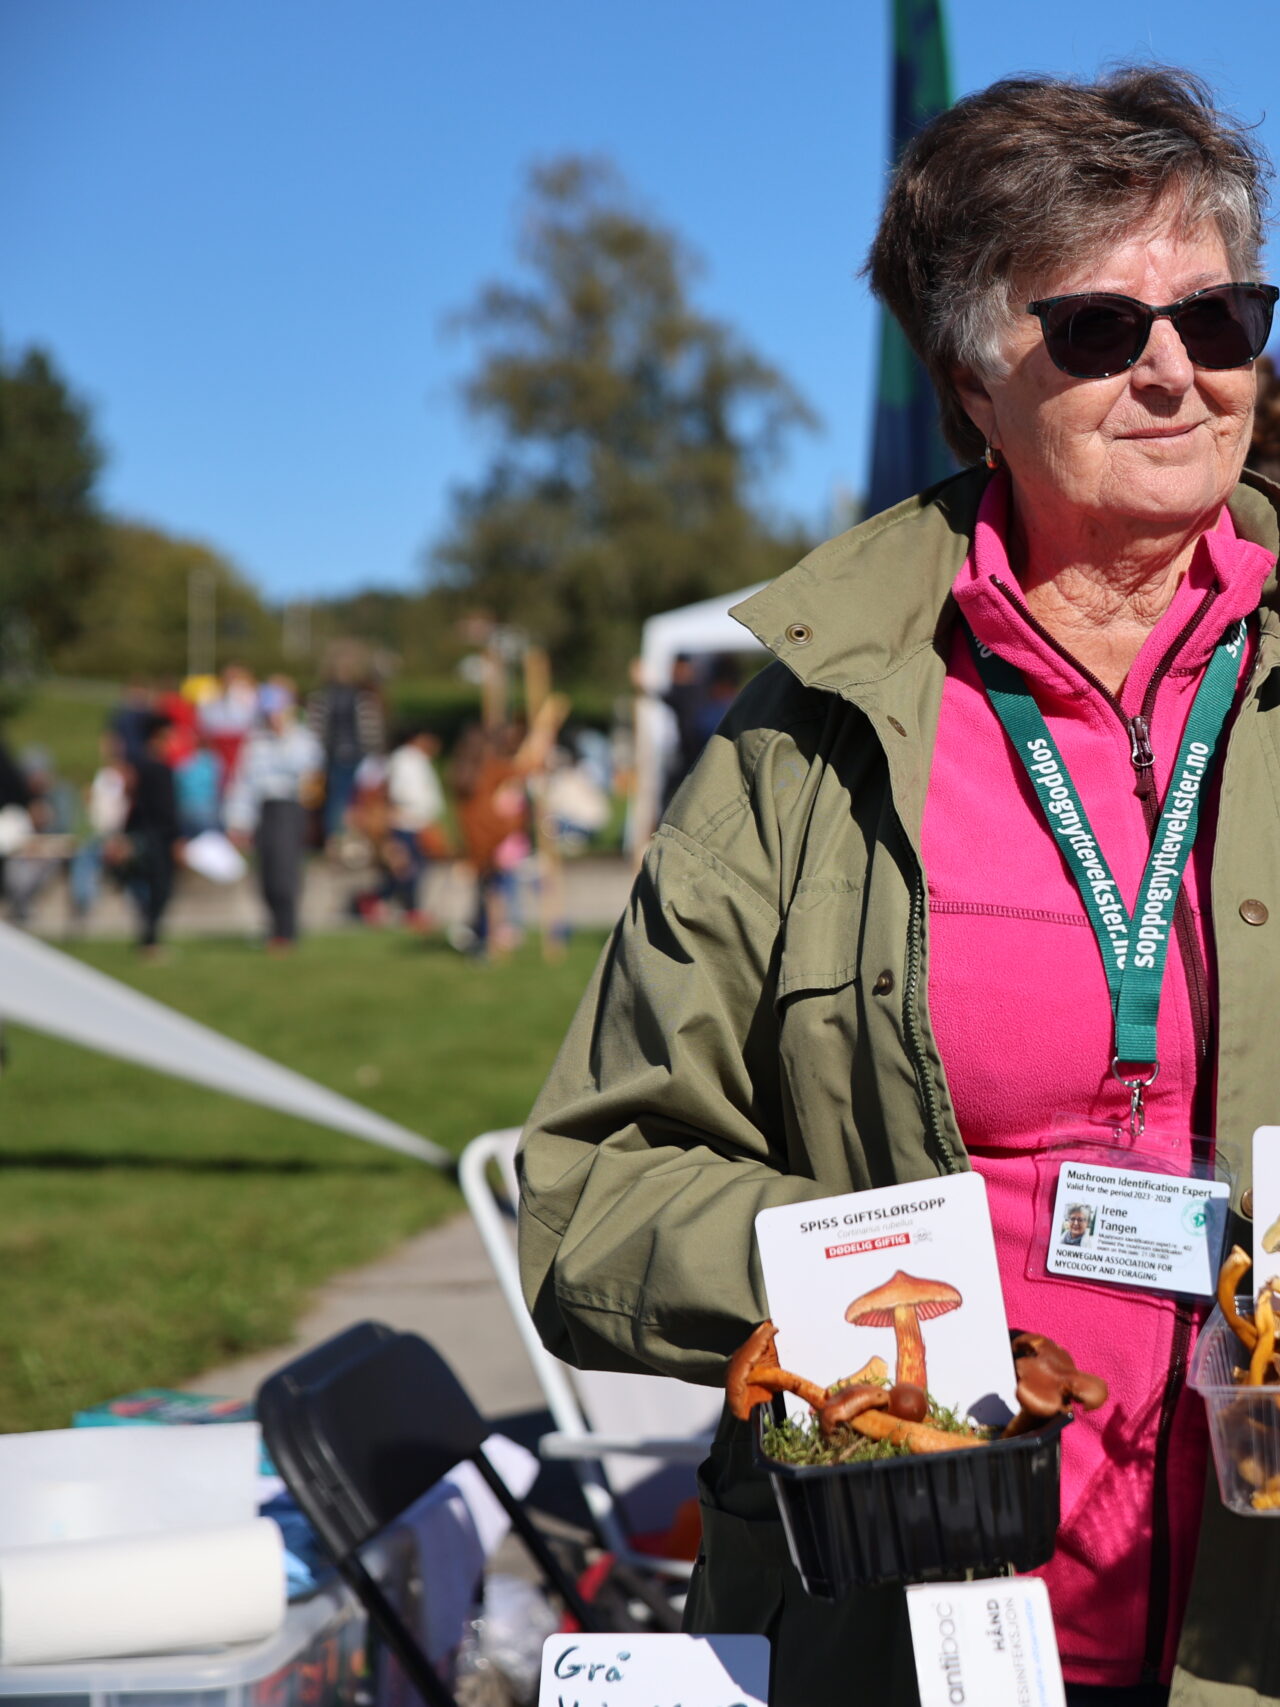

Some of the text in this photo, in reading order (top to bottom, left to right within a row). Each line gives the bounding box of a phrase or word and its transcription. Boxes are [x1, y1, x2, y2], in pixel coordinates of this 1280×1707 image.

[1134, 742, 1209, 968] soppognyttevekster.no
[1066, 1182, 1084, 1191] Valid
[1085, 1184, 1095, 1193] for
[1097, 1185, 1108, 1194] the
[1110, 1187, 1133, 1198] period
[1067, 1169, 1212, 1200] Mushroom Identification Expert
[800, 1197, 946, 1233] SPISS GIFTSLØRSOPP
[1101, 1205, 1128, 1218] Irene
[1100, 1220, 1137, 1235] Tangen
[829, 1233, 907, 1257] DØDELIG GIFTIG
[1056, 1249, 1103, 1262] NORWEGIAN
[1104, 1255, 1156, 1270] ASSOCIATION
[1157, 1262, 1172, 1272] FOR
[1054, 1259, 1157, 1281] MYCOLOGY AND FORAGING
[985, 1598, 1006, 1653] HÅND
[554, 1645, 631, 1682] Grå
[934, 1601, 966, 1705] antibac
[1005, 1596, 1030, 1707] ESINFEKSJON
